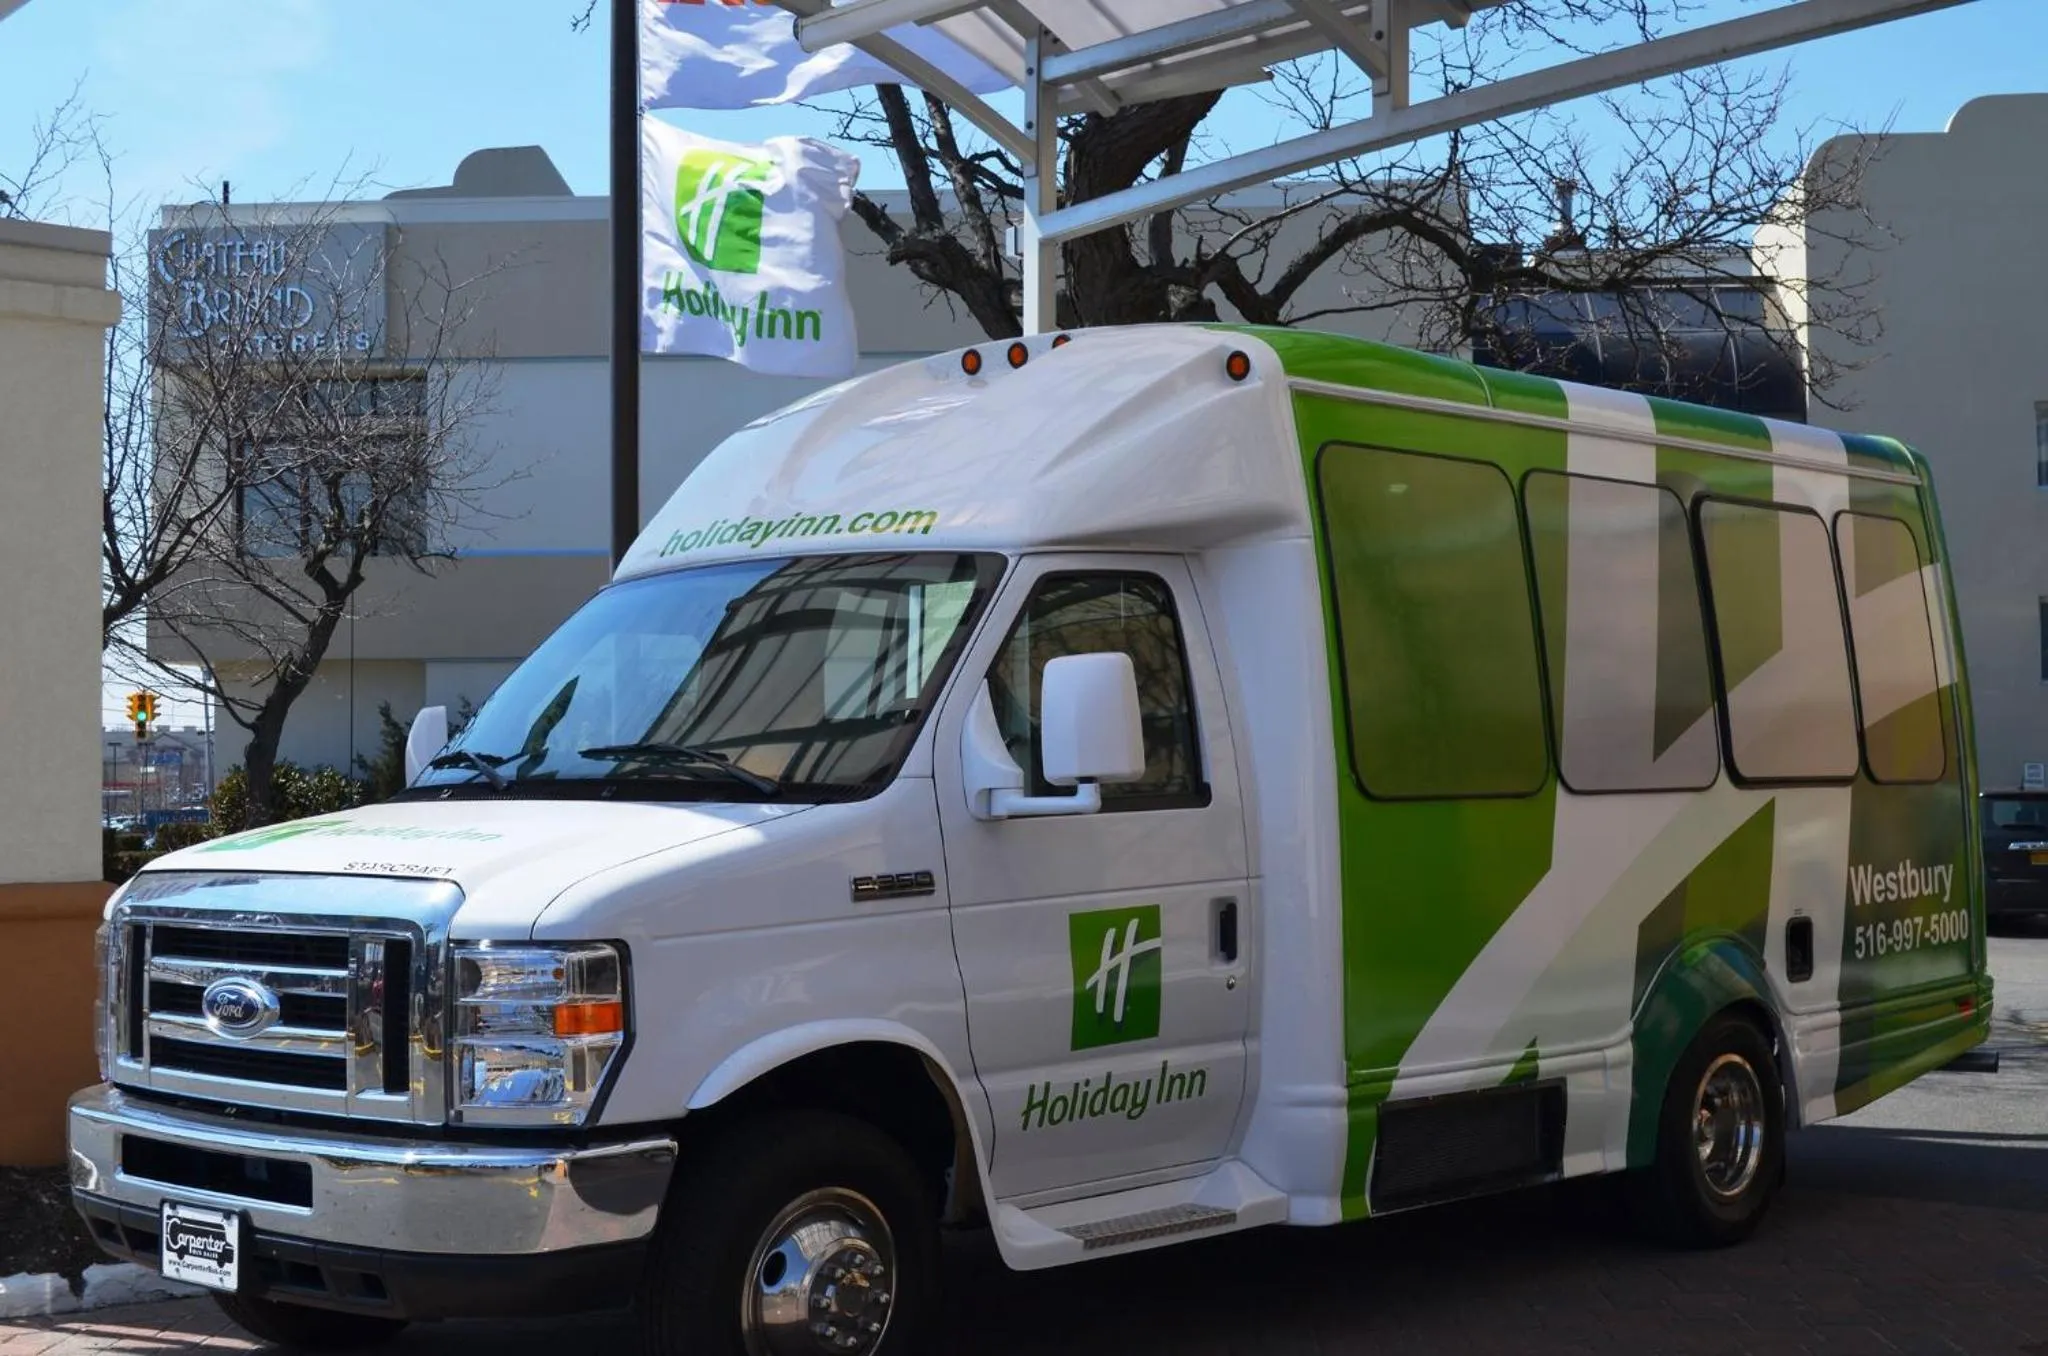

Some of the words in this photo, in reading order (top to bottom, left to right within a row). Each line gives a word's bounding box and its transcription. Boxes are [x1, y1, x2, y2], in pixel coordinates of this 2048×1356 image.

[755, 290, 820, 341] Inn
[659, 509, 938, 557] holidayinn.com
[1850, 859, 1954, 906] Westbury
[1855, 908, 1969, 960] 516-997-5000
[213, 993, 245, 1018] Ford
[1021, 1071, 1152, 1131] Holiday
[1155, 1060, 1207, 1105] Inn
[167, 1217, 226, 1254] Carpenter
